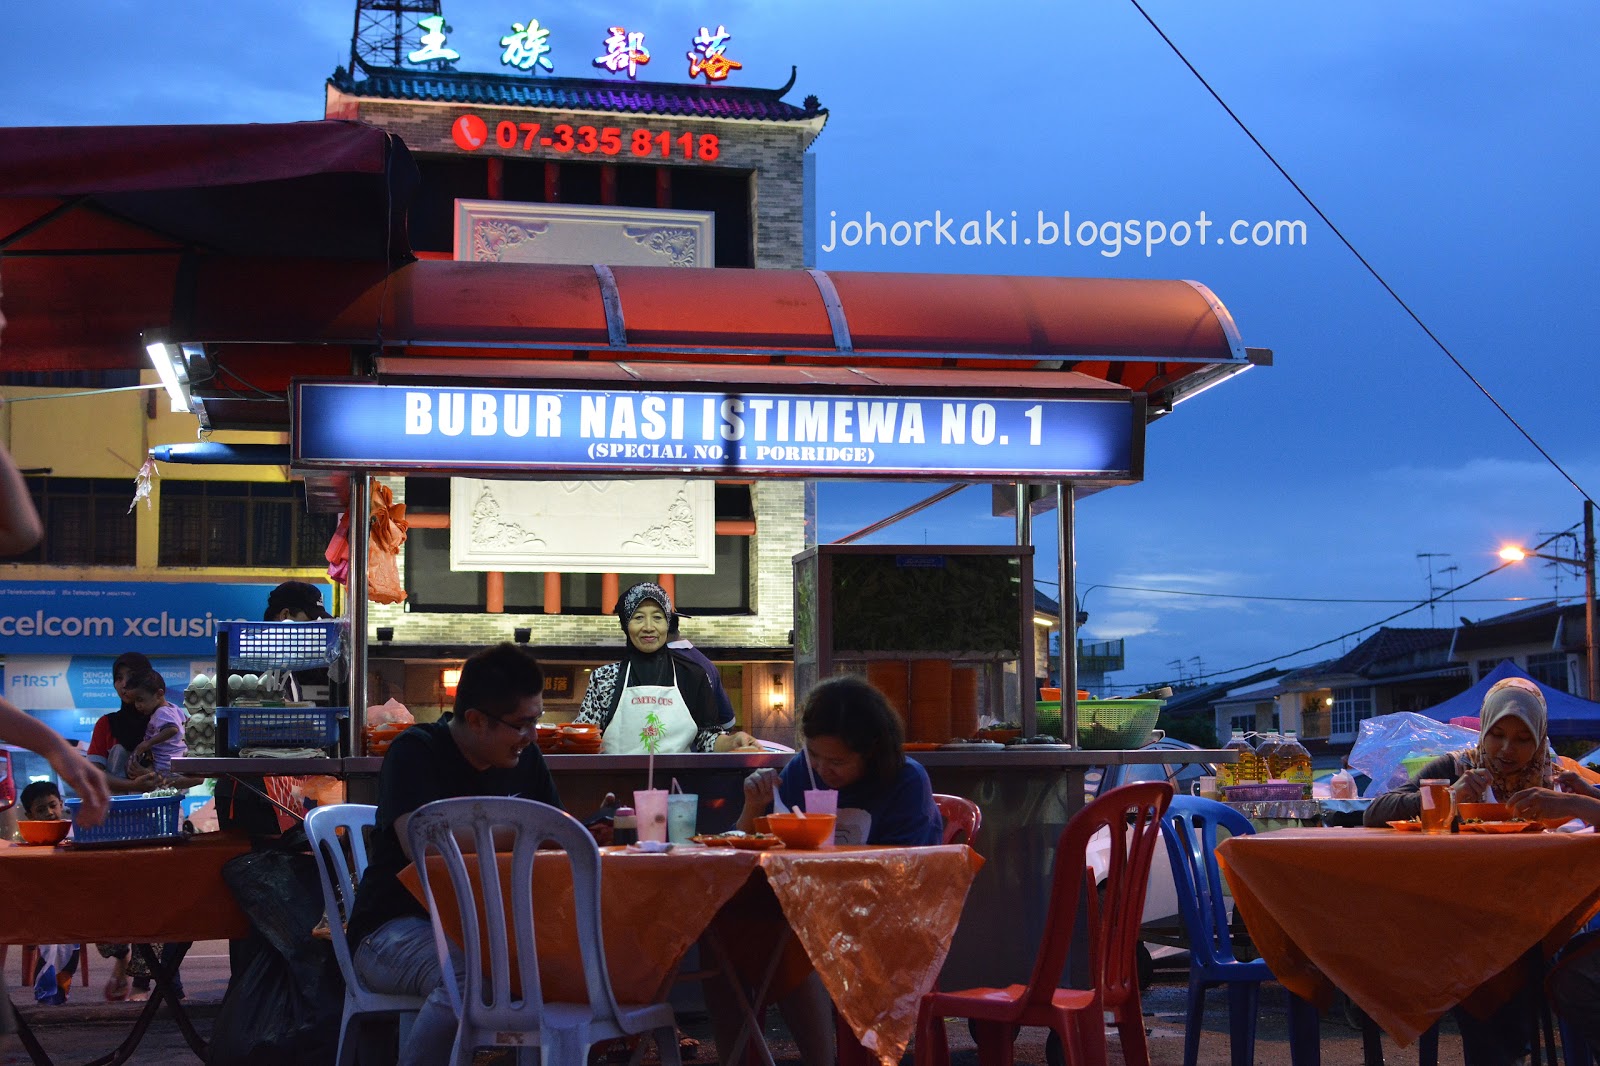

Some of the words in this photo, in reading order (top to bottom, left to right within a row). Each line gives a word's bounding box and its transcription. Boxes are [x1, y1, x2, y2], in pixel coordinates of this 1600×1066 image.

[408, 16, 743, 80] 王族部落
[497, 120, 622, 155] 07-335
[631, 129, 720, 161] 8118
[405, 391, 562, 437] BUBUR
[580, 395, 685, 440] NASI
[702, 398, 926, 445] ISTIMEWA
[941, 403, 1009, 446] NO.
[1025, 405, 1043, 446] 1
[587, 442, 688, 460] (SPECIAL
[694, 445, 730, 460] NO.
[739, 446, 748, 460] 1
[756, 446, 875, 464] PORRIDGE)
[0, 610, 114, 637] celcom
[123, 611, 248, 637] xclusi
[12, 674, 59, 687] FIRST
